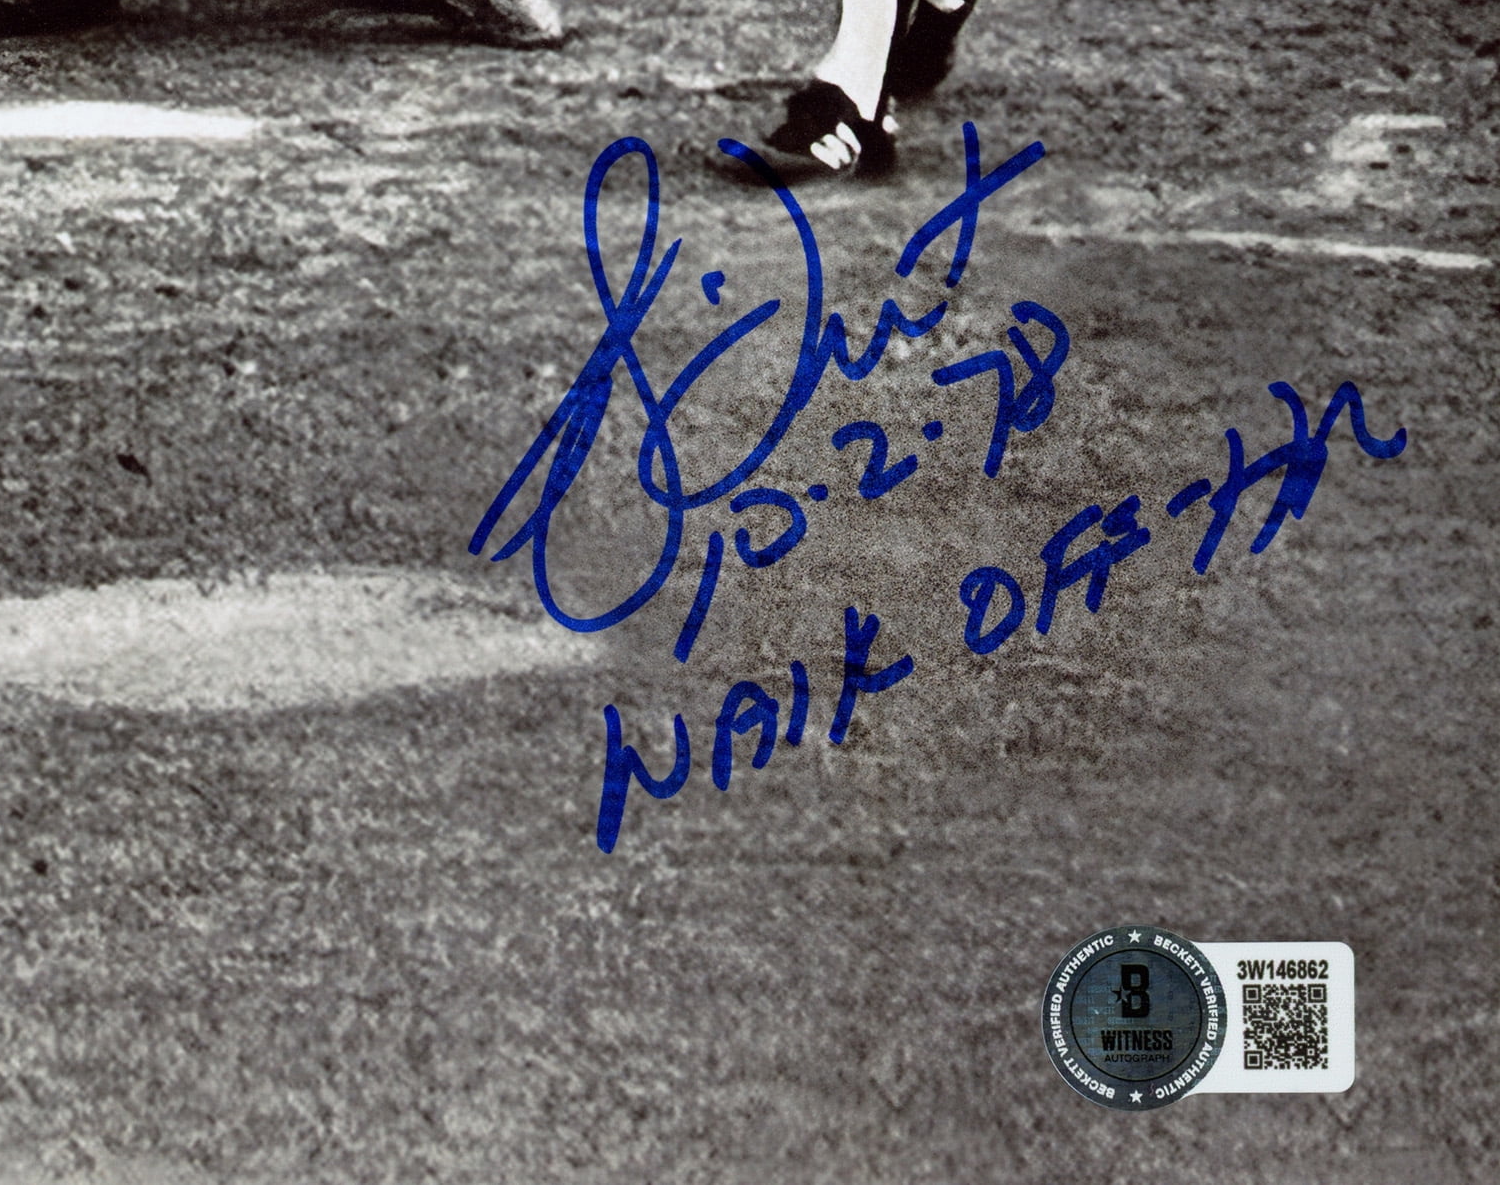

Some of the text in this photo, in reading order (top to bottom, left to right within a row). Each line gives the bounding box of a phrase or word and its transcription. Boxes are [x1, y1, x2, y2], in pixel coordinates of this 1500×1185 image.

[1055, 934, 1114, 993] AUTHENTIC
[1237, 960, 1329, 980] 3W146862
[1050, 993, 1069, 1058] VERIFIED
[1153, 934, 1219, 1100] BECKETT VERIFIED AUTHENTIC
[1101, 1029, 1173, 1051] WITNESS
[1104, 1054, 1170, 1063] AUTOGRAPH
[1063, 1057, 1116, 1100] BECKETT
